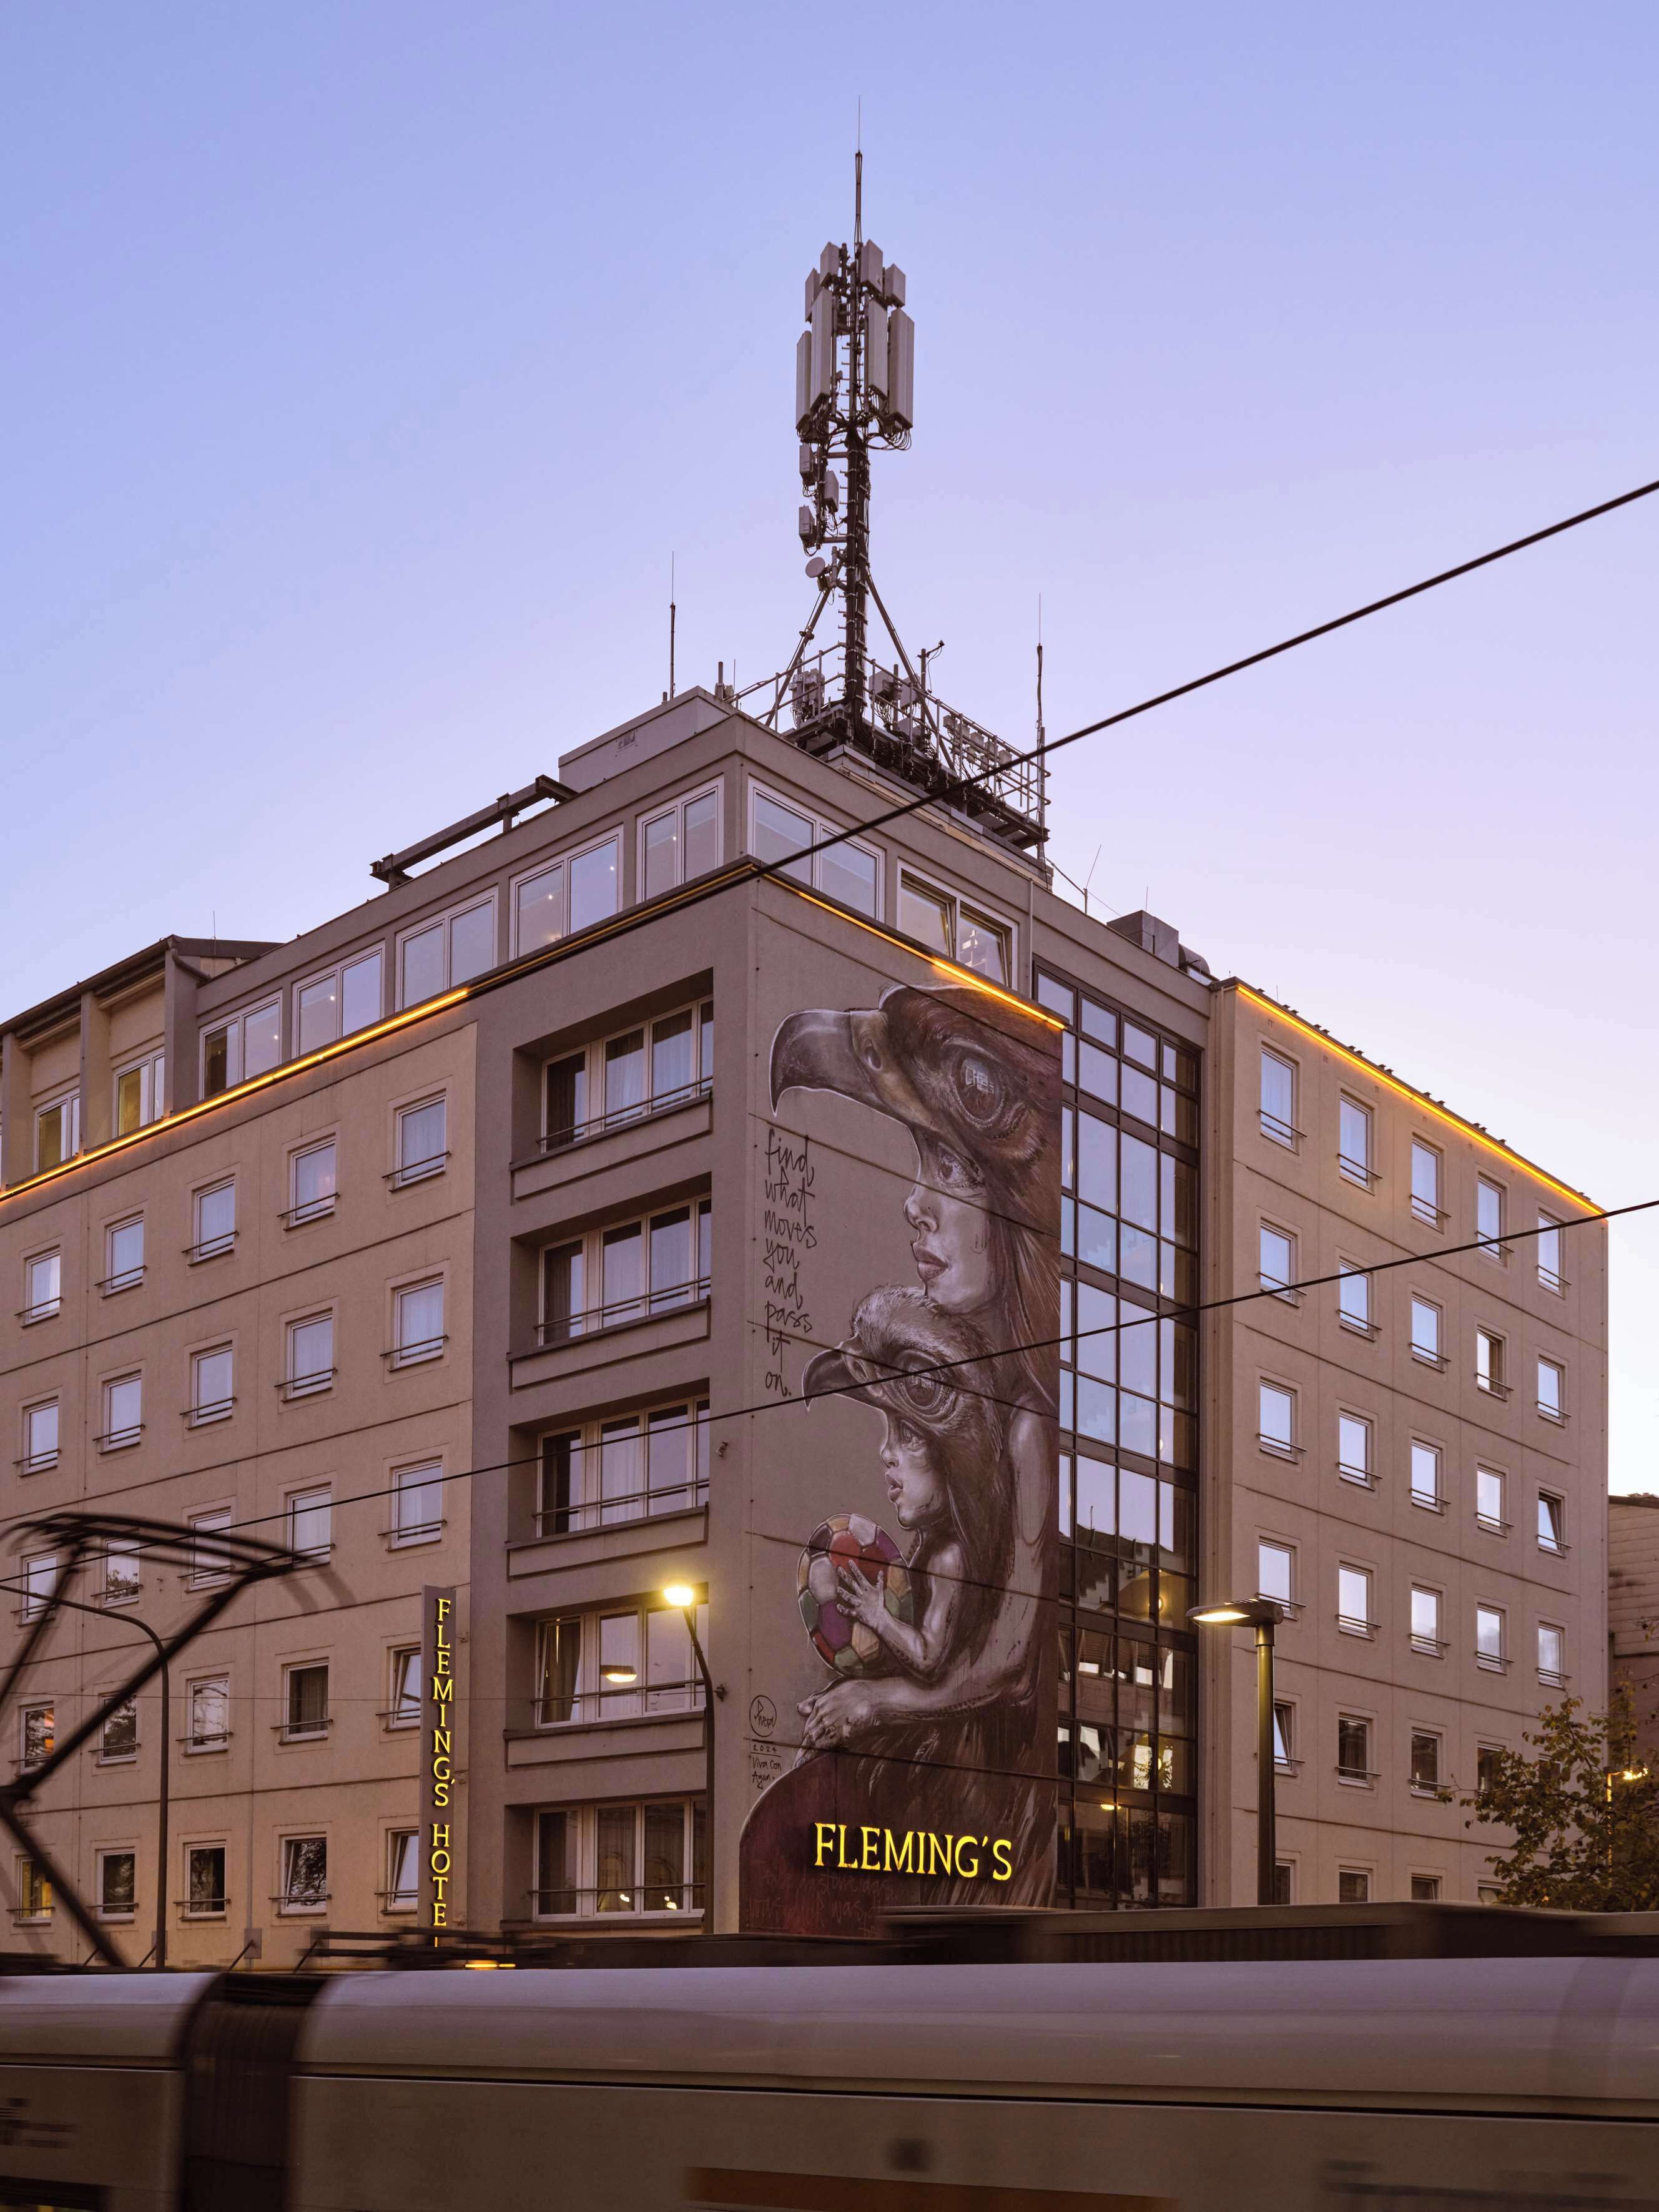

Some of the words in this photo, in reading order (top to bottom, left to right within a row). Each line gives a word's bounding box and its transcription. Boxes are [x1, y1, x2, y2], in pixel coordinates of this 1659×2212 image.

[765, 1128, 814, 1187] find
[765, 1166, 815, 1227] what
[764, 1210, 817, 1248] moves
[764, 1238, 800, 1273] you
[765, 1272, 803, 1310] and
[766, 1300, 812, 1343] pass
[772, 1330, 790, 1372] it
[433, 1598, 455, 1807] FLEMING'S
[814, 1822, 1012, 1881] FLEMING'S
[431, 1824, 450, 1947] HOTE
